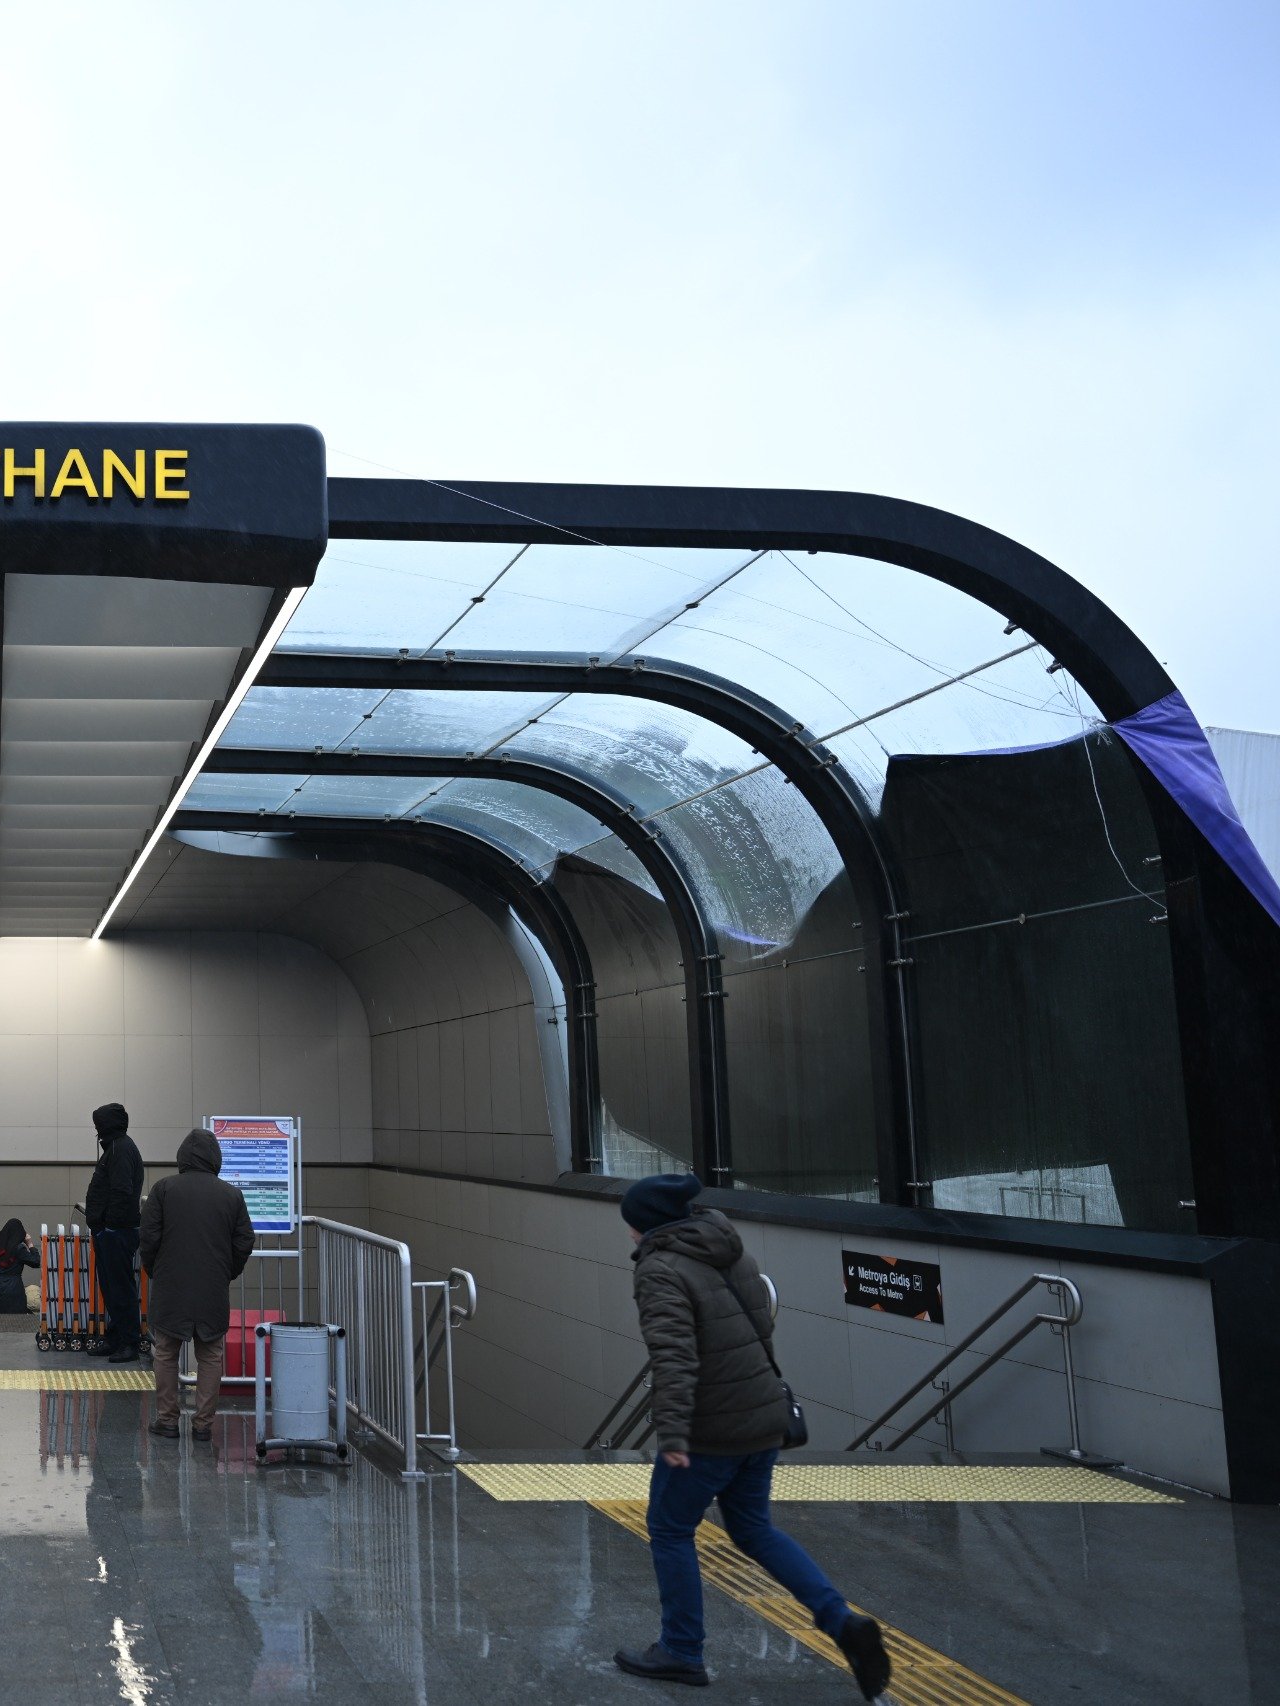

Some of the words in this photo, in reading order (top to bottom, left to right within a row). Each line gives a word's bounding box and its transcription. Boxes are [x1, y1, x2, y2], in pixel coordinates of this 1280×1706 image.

[858, 1266, 888, 1285] Metroya
[889, 1272, 911, 1291] Gidiş
[859, 1283, 879, 1296] Access
[879, 1287, 887, 1297] To
[886, 1288, 904, 1300] Metro
